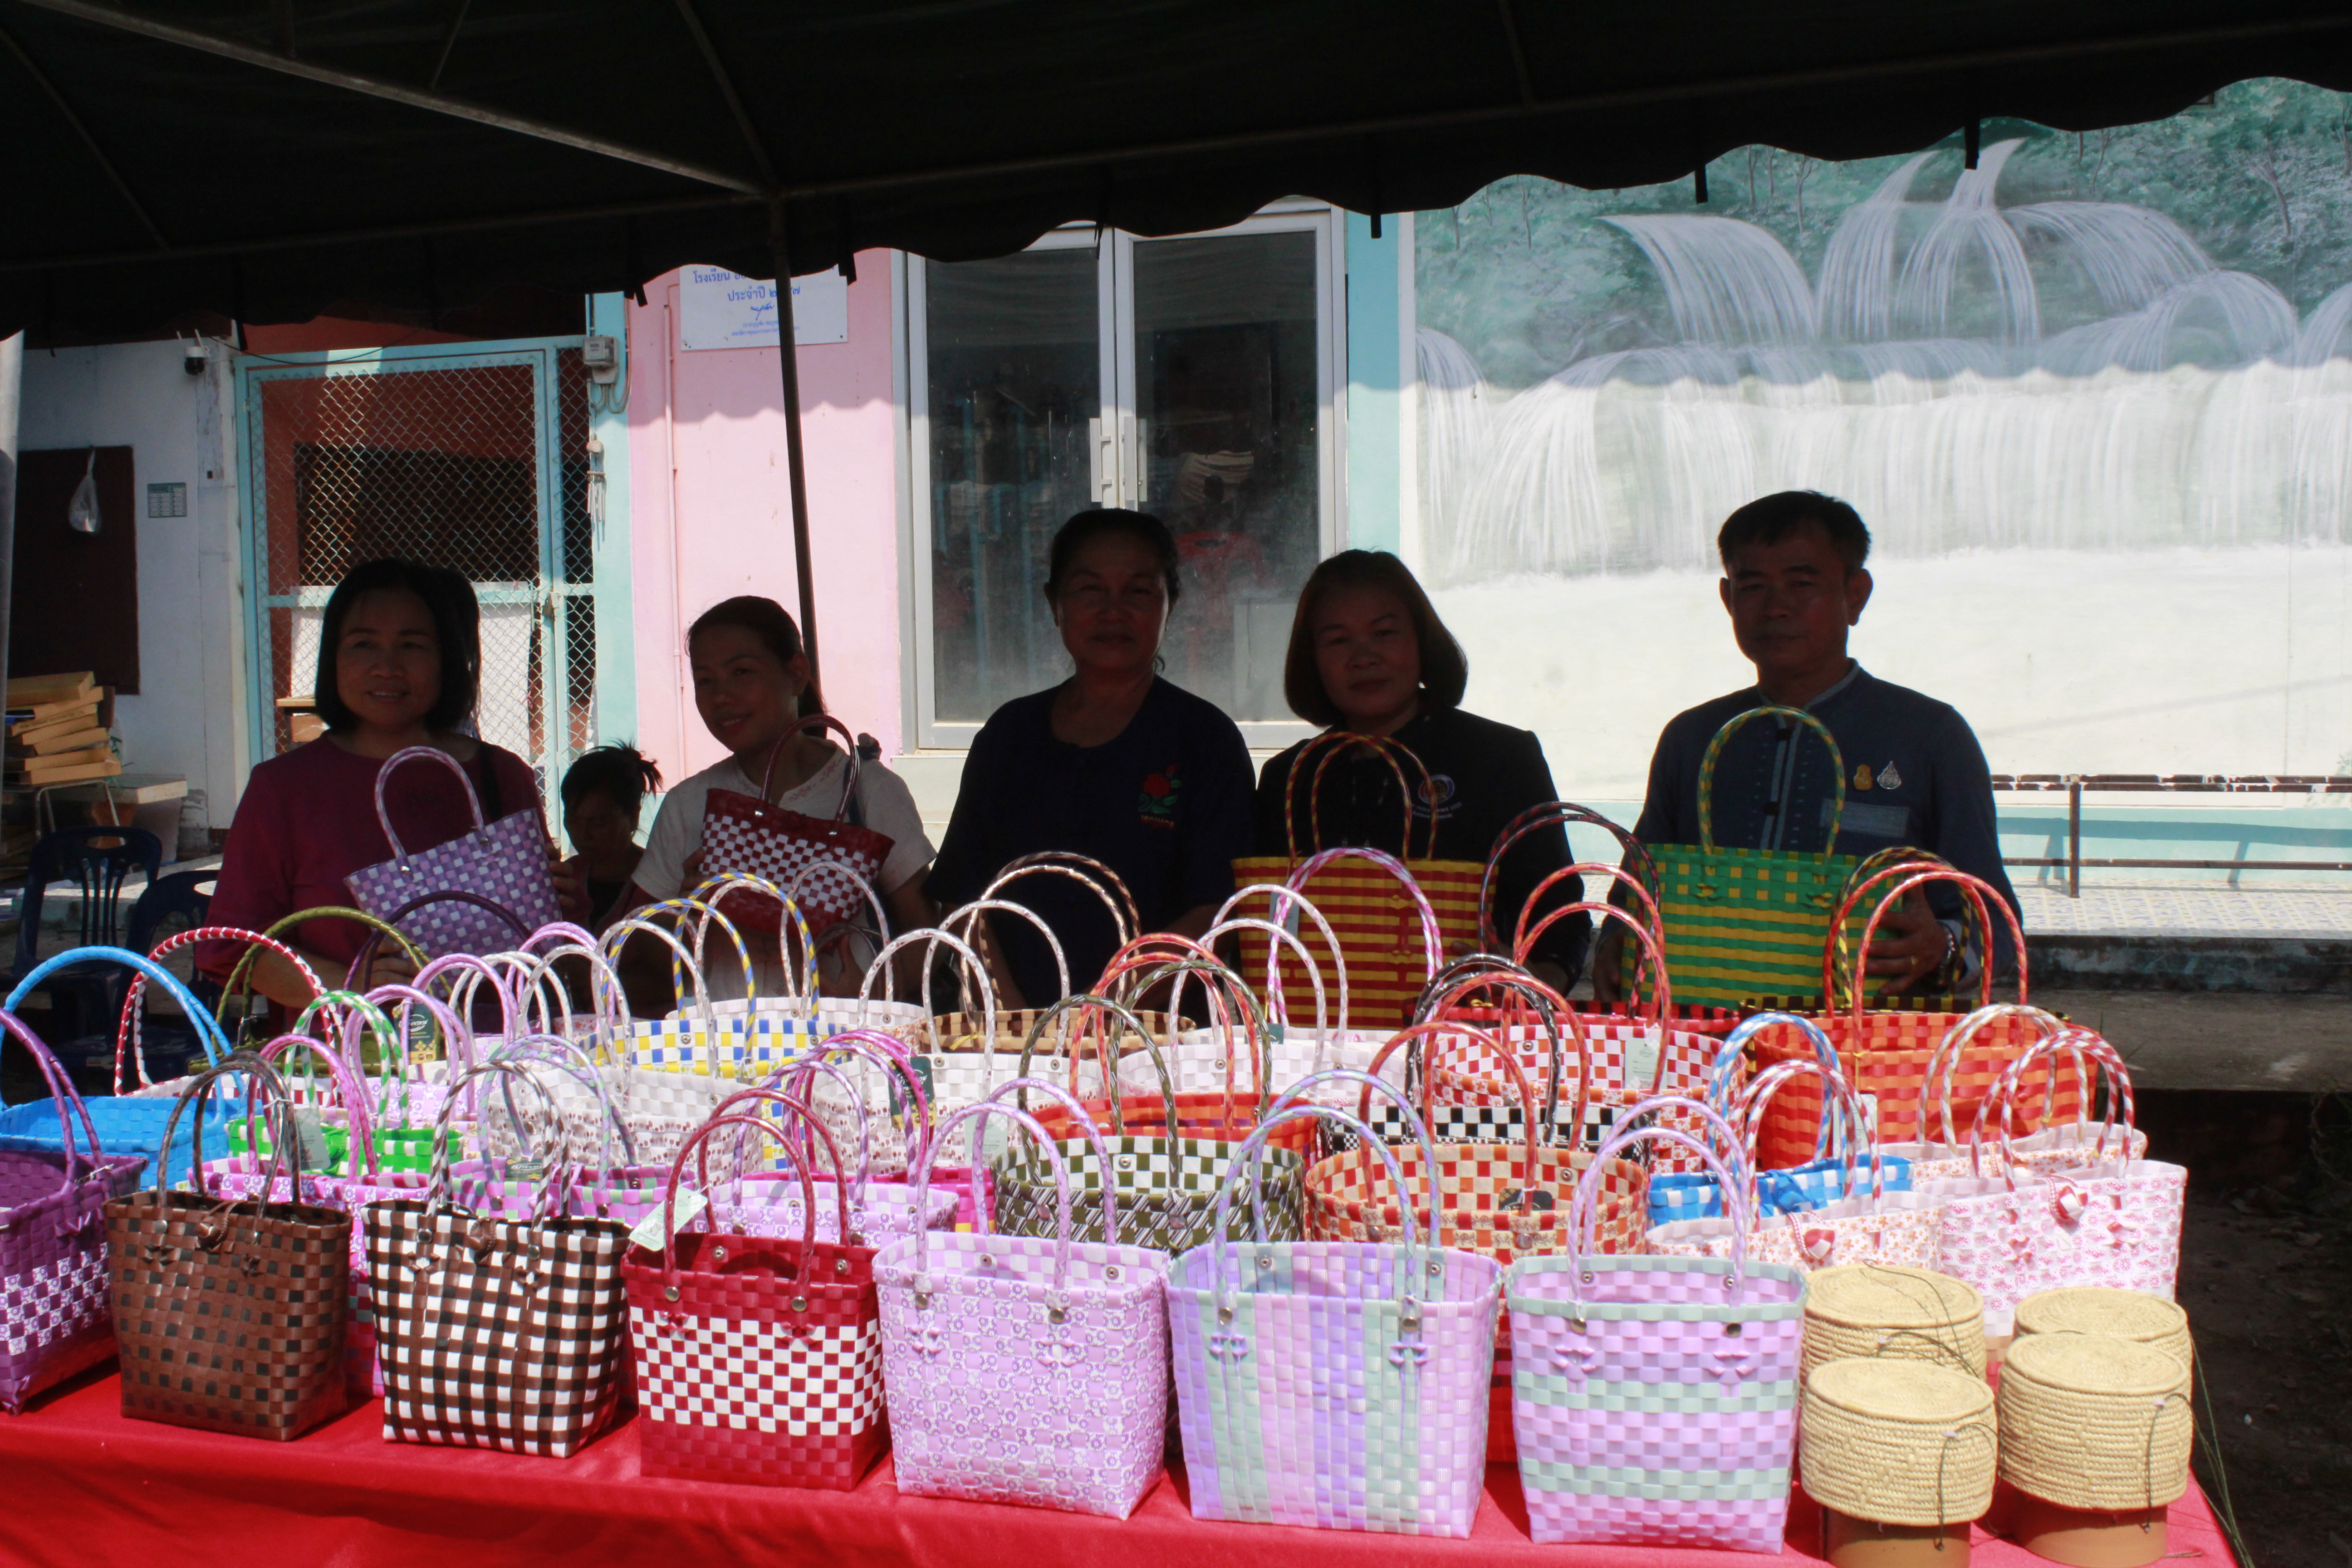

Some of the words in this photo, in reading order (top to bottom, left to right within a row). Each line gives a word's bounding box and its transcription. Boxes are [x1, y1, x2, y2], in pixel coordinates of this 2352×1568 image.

[693, 268, 730, 283] โรงเรียน
[727, 285, 765, 301] ประจำปี
[769, 286, 800, 297] ๒๗
